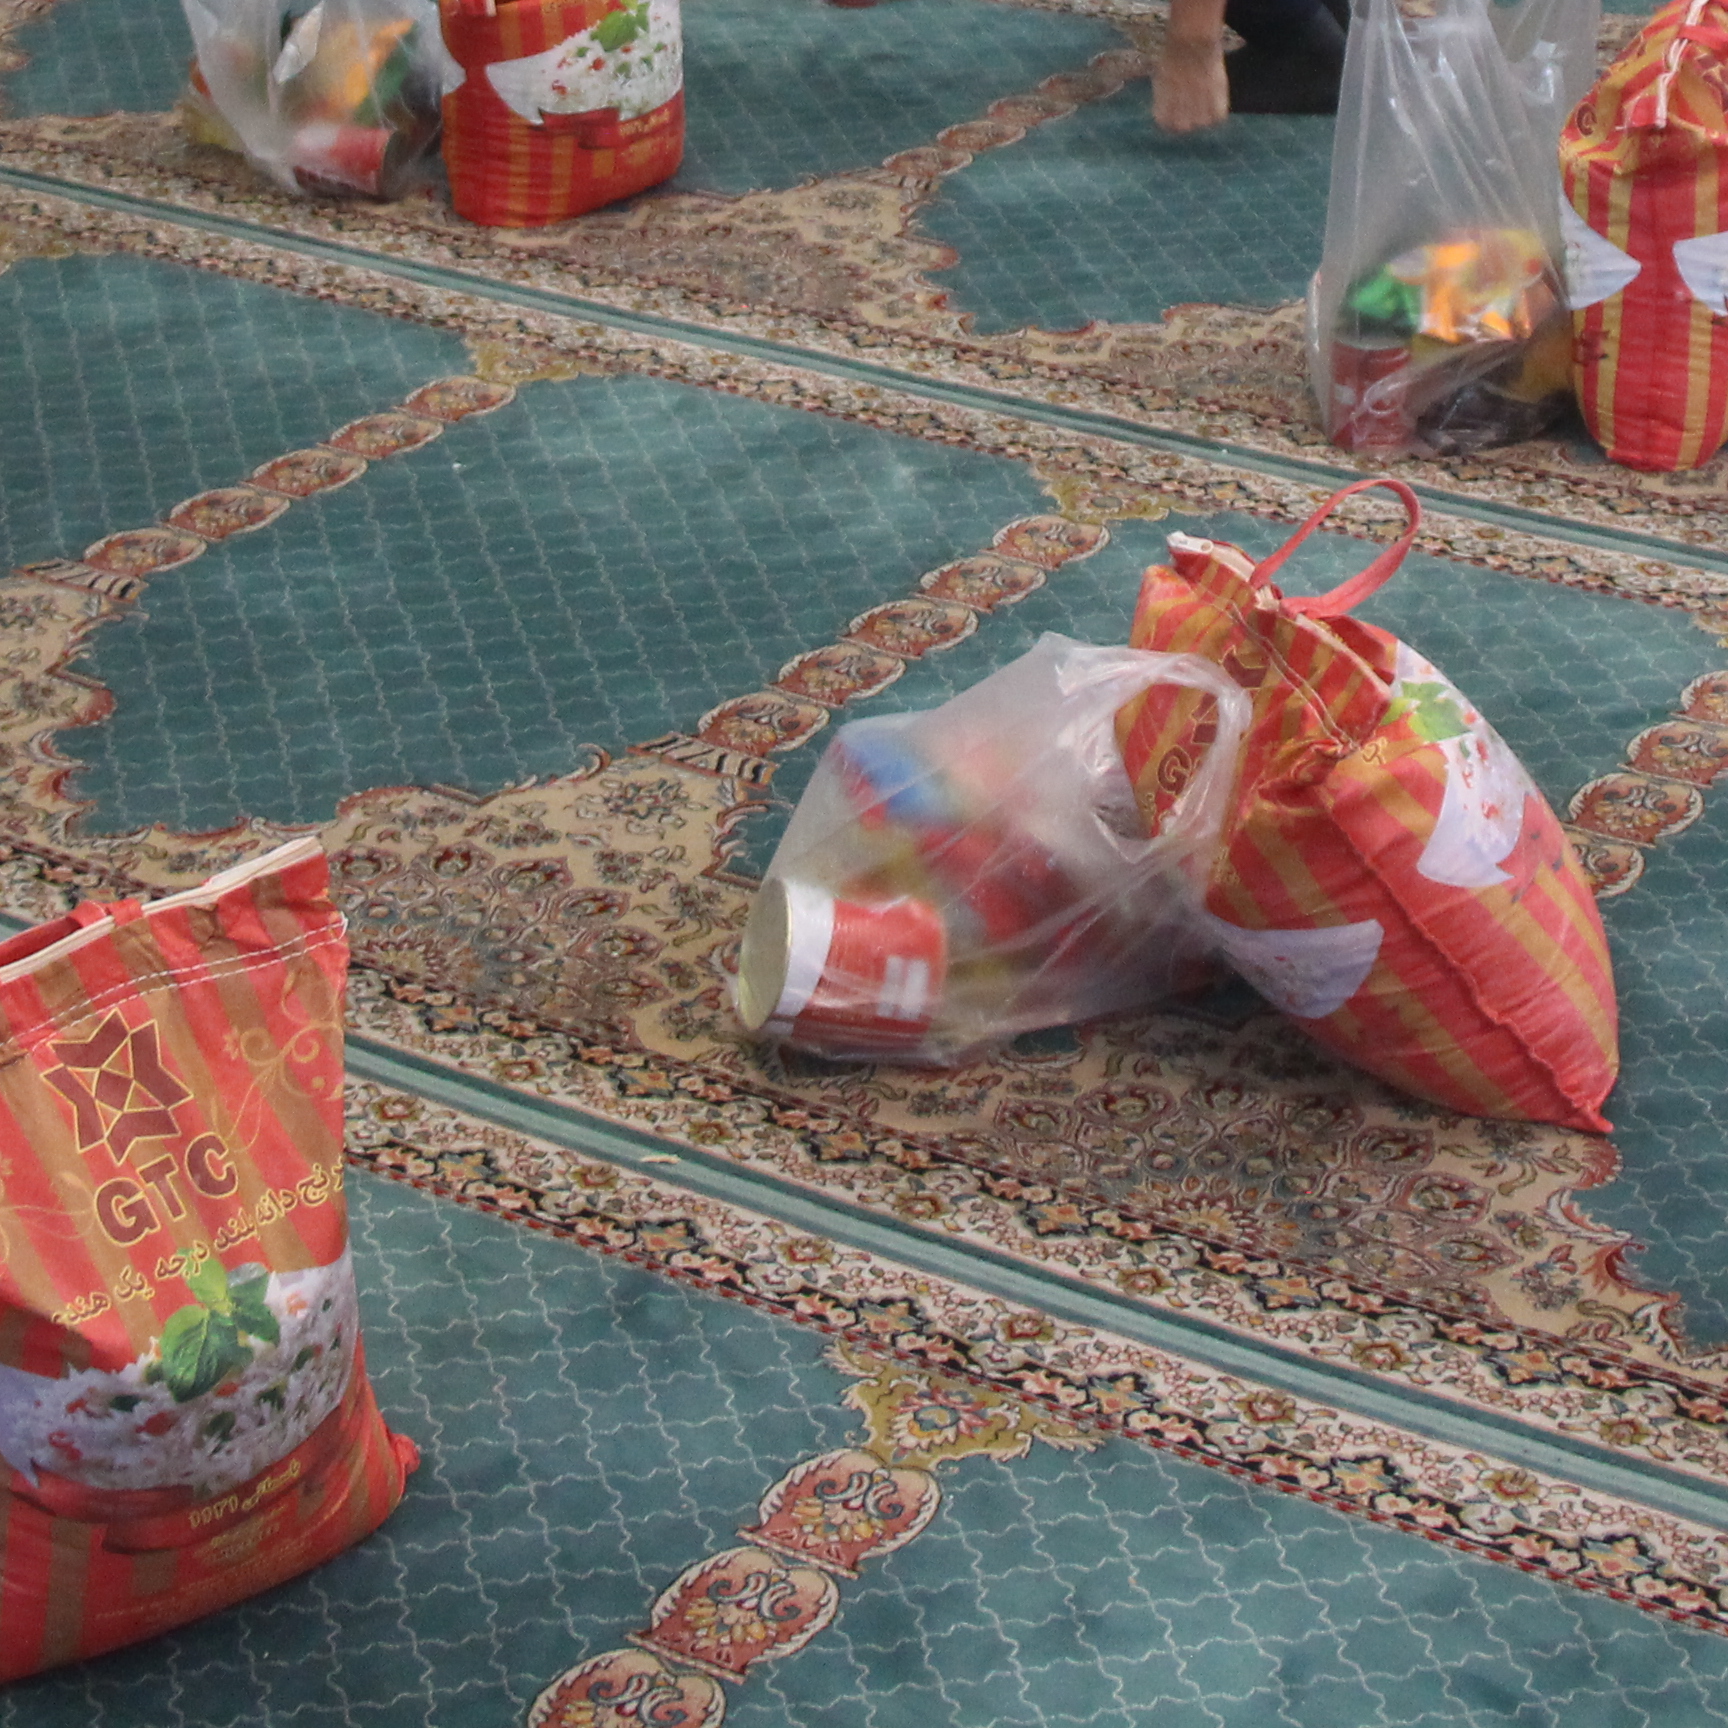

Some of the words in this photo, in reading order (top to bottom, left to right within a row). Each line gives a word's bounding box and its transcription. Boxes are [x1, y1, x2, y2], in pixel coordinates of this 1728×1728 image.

[95, 1131, 239, 1248] GTC
[153, 1239, 211, 1281] درجه
[113, 1265, 156, 1303] یک
